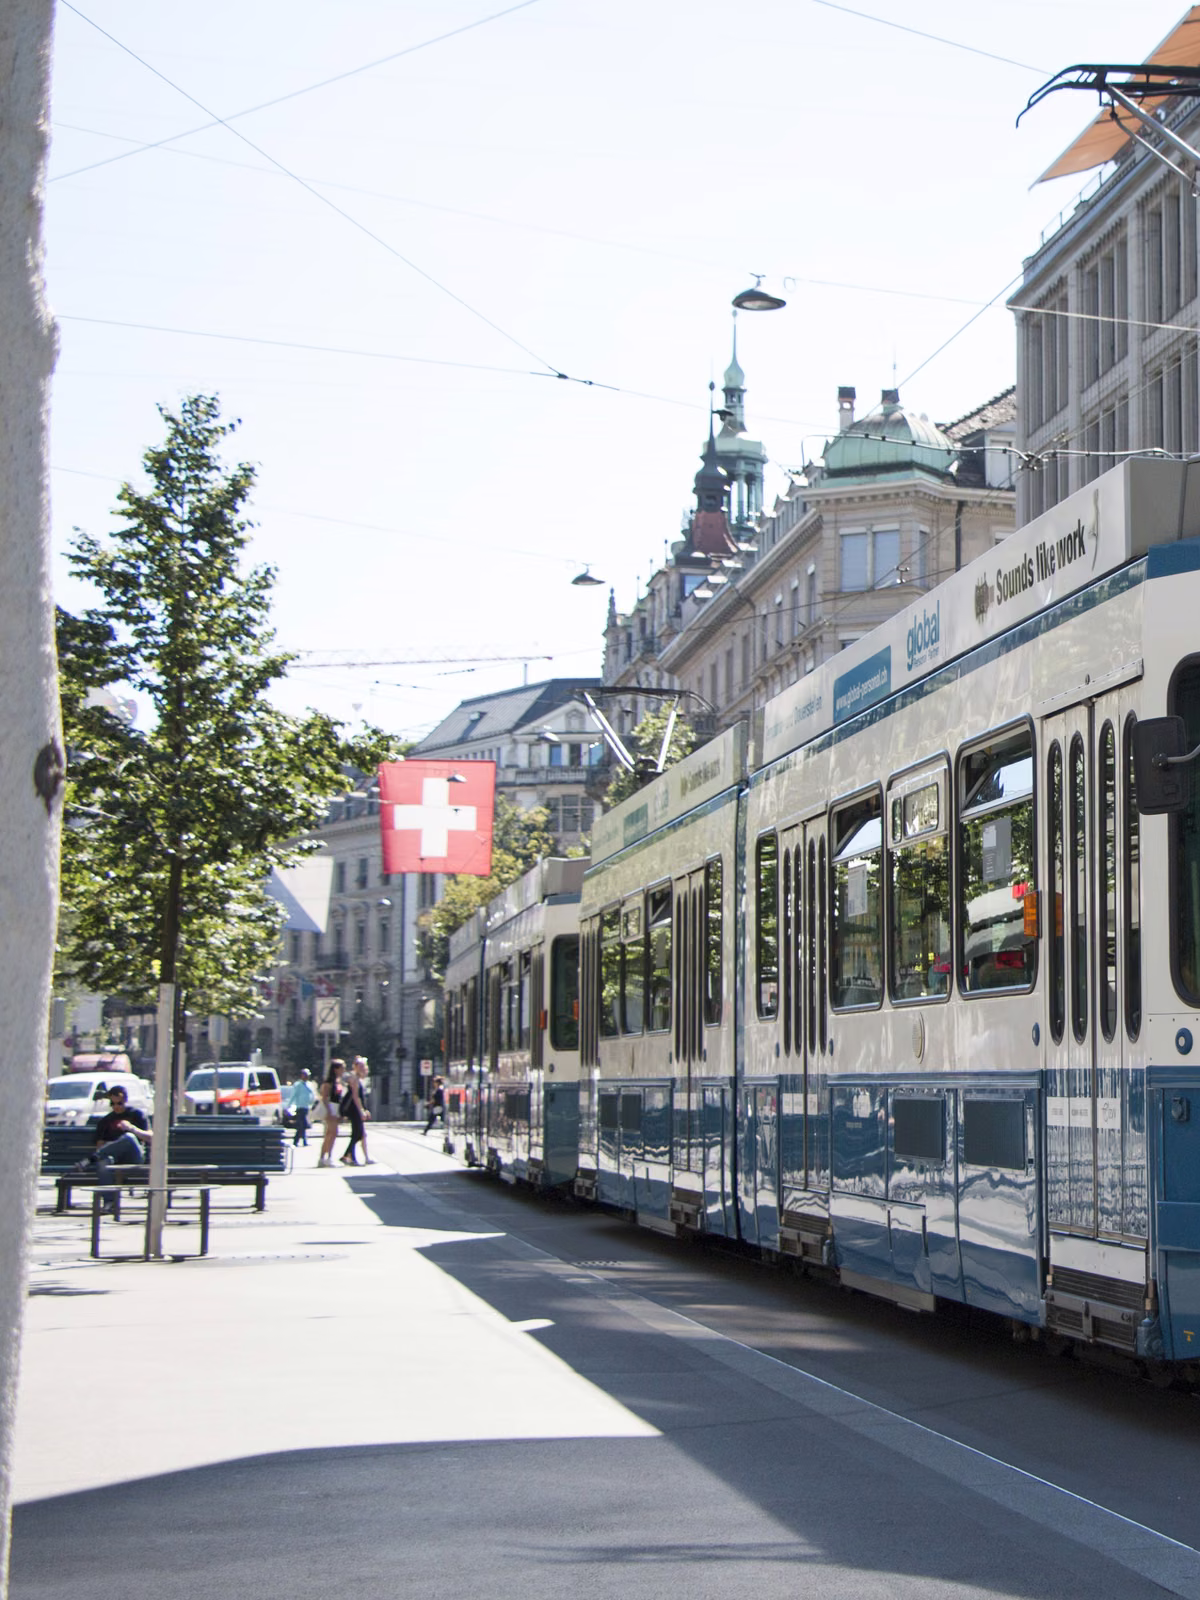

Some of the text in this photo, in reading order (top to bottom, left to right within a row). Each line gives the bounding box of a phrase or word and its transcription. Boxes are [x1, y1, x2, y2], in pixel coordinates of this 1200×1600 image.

[996, 518, 1086, 606] Sounds like work
[907, 600, 940, 672] global
